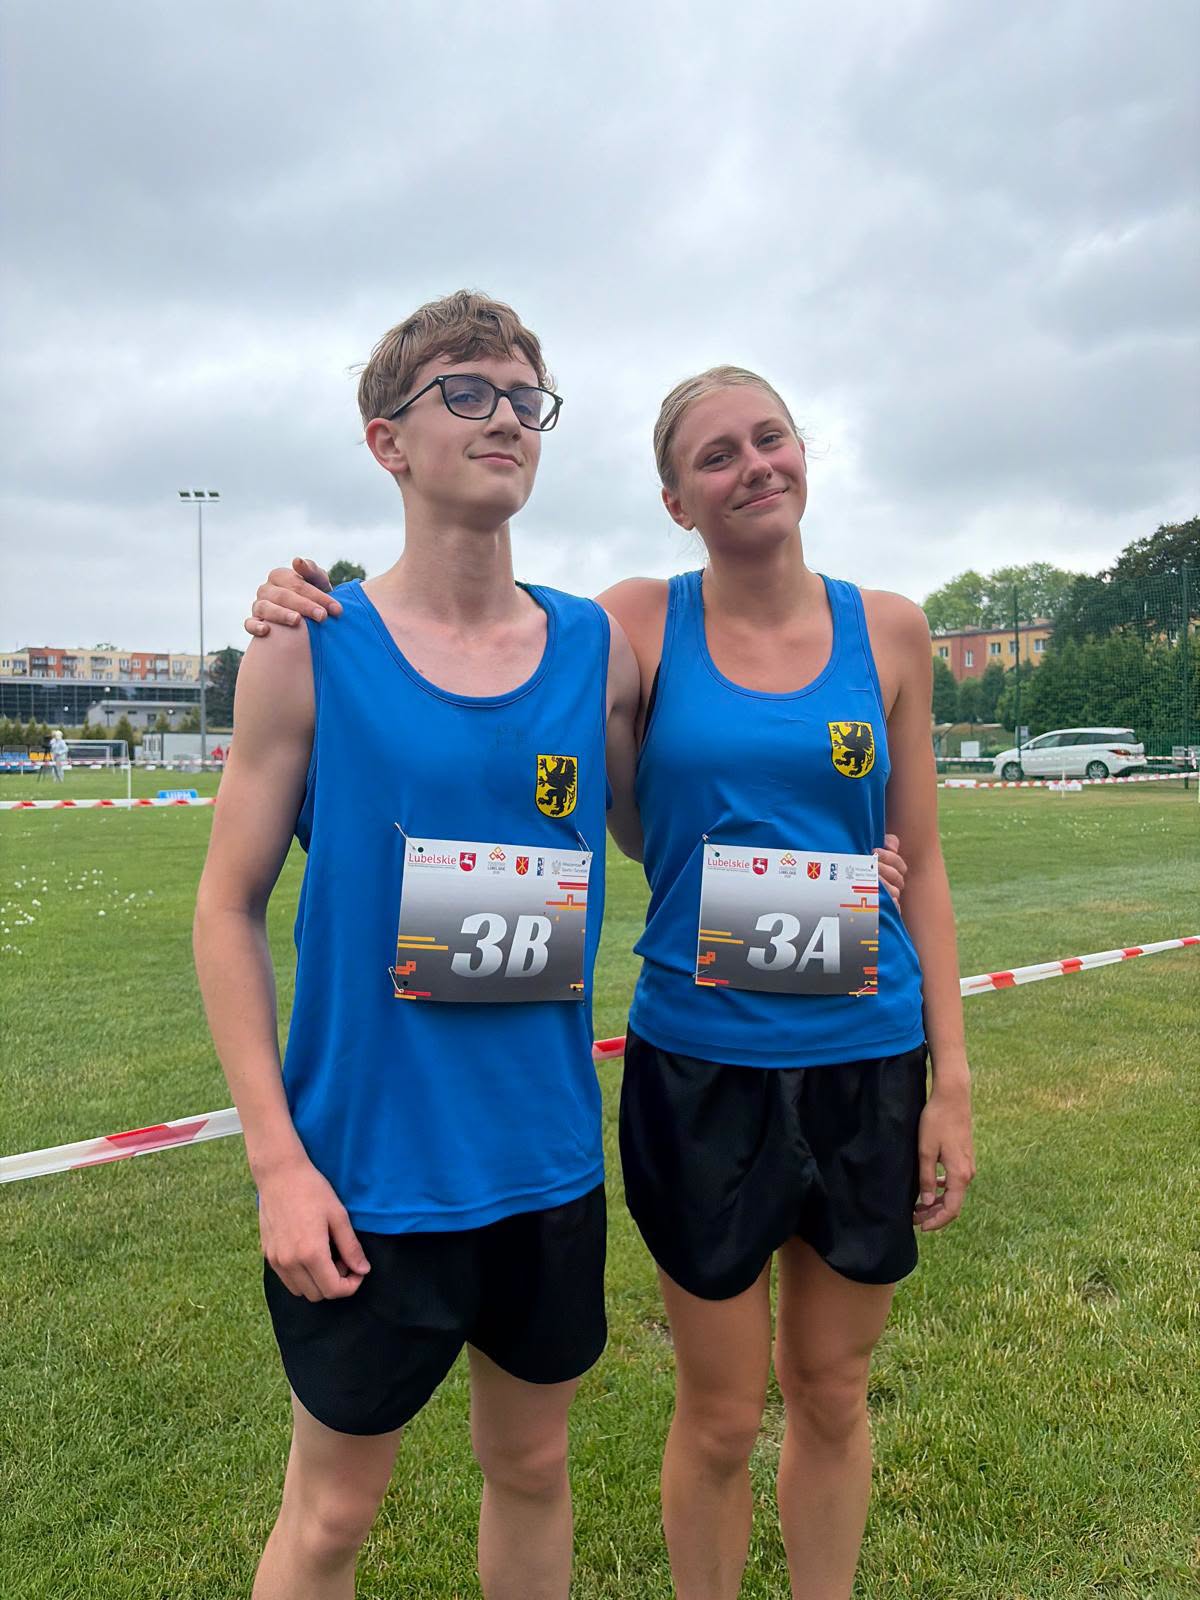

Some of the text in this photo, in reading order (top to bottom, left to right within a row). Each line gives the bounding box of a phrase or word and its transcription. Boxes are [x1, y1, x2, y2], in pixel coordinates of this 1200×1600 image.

[408, 853, 457, 865] Lubelskie
[707, 858, 750, 869] Lubelskie
[450, 912, 552, 979] 3B
[746, 912, 841, 974] 3A
